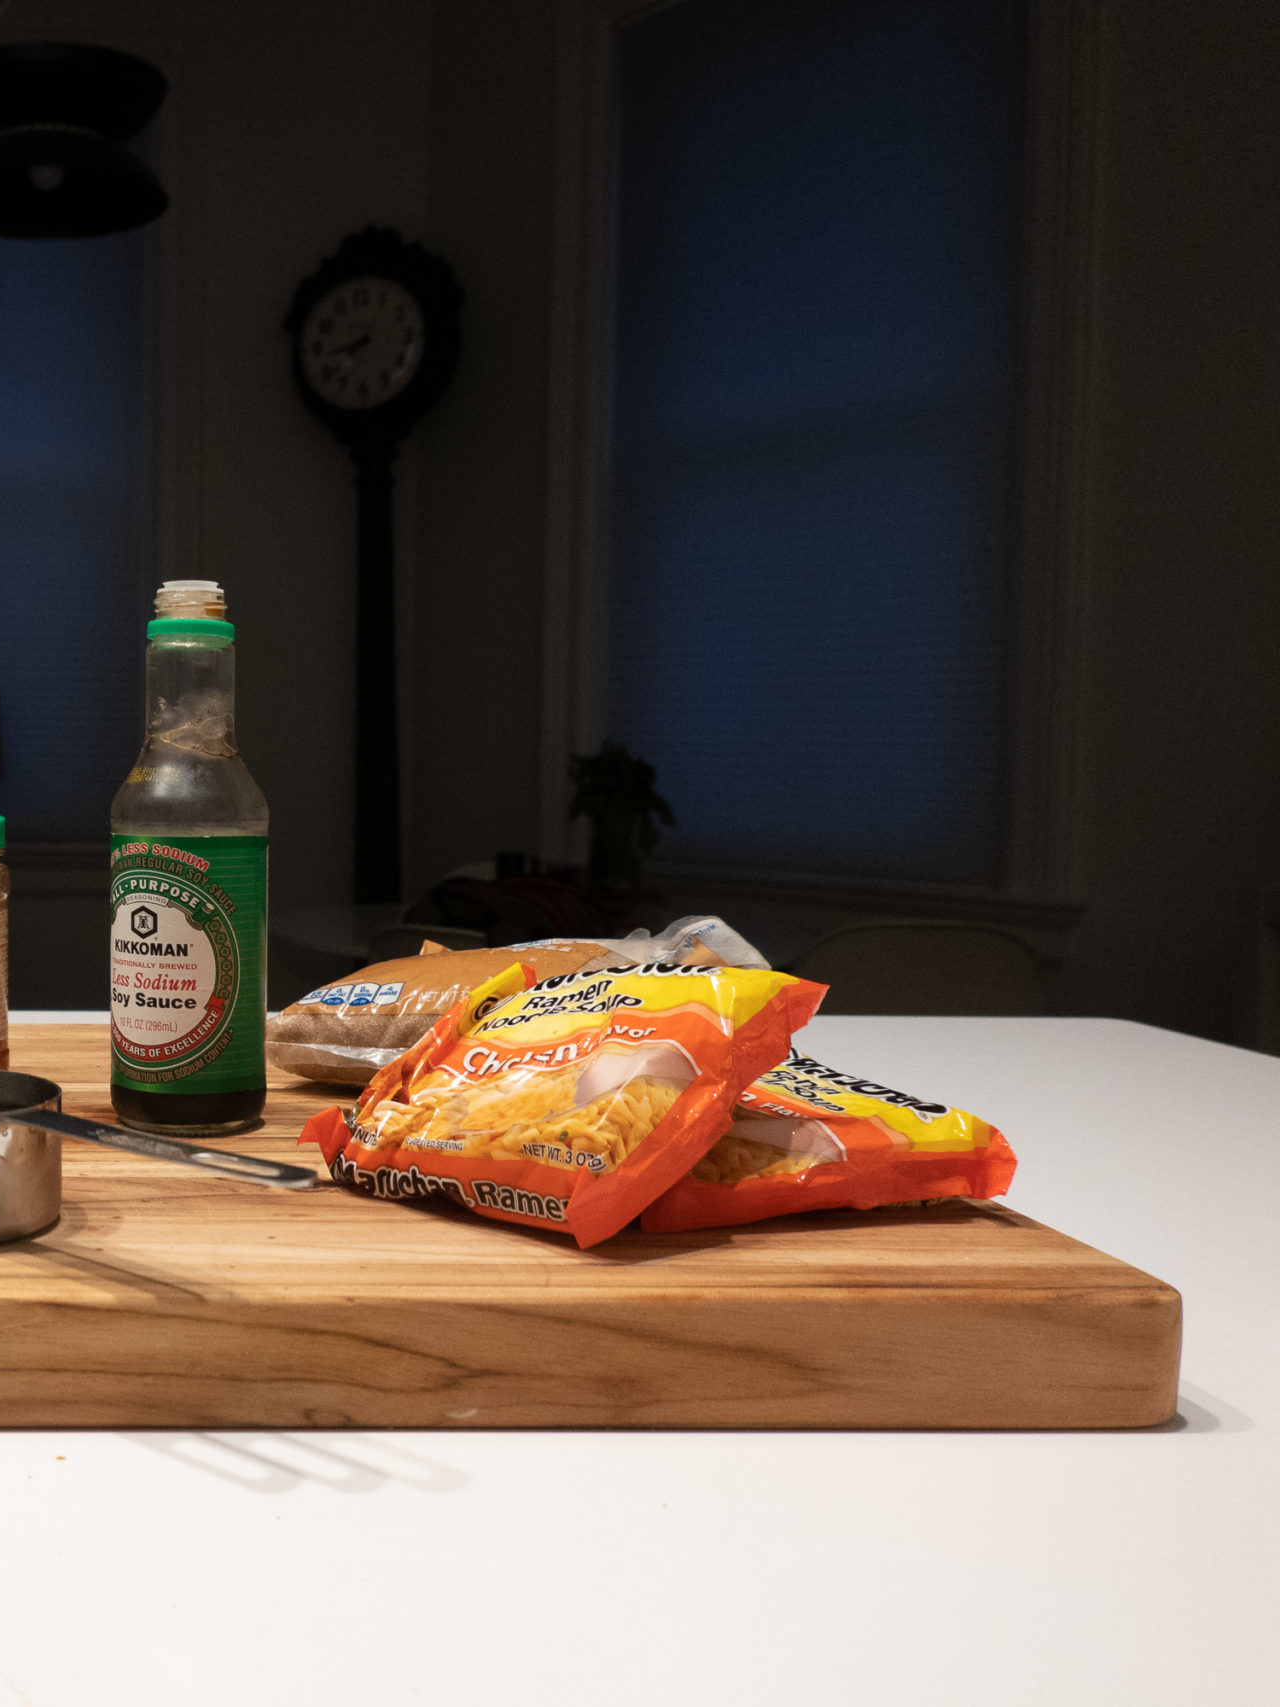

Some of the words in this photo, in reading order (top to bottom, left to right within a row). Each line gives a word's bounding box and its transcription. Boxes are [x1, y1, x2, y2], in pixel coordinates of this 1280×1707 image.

[122, 843, 148, 856] LESS
[152, 844, 210, 872] SODIUM
[135, 856, 184, 875] REGULAR
[187, 868, 210, 887] SOY
[208, 883, 238, 915] SAUCE
[126, 894, 168, 905] SEASONING
[115, 939, 189, 957] KIKKOMAN
[112, 957, 156, 969] TRADITIONALLY
[112, 967, 130, 987] Less
[134, 972, 197, 991] Sodium
[112, 987, 131, 1008] Soy
[135, 992, 197, 1009] Sauce
[522, 979, 613, 1011] Ramen
[569, 992, 644, 1014] Soup
[121, 1041, 146, 1057] YEARS
[148, 1048, 162, 1058] OF
[164, 1010, 220, 1056] EXCELLENCE
[127, 1018, 133, 1029] FL
[134, 1019, 144, 1029] OZ
[145, 1020, 178, 1034] (296mL)
[159, 1071, 174, 1082] FOR
[175, 1060, 206, 1080] SODIUM
[463, 1044, 578, 1077] Chicn
[436, 1140, 464, 1151] SERVING
[523, 1143, 546, 1158] NET
[547, 1146, 562, 1163] WT.
[565, 1149, 573, 1164] 3
[471, 1180, 570, 1222] Rame
